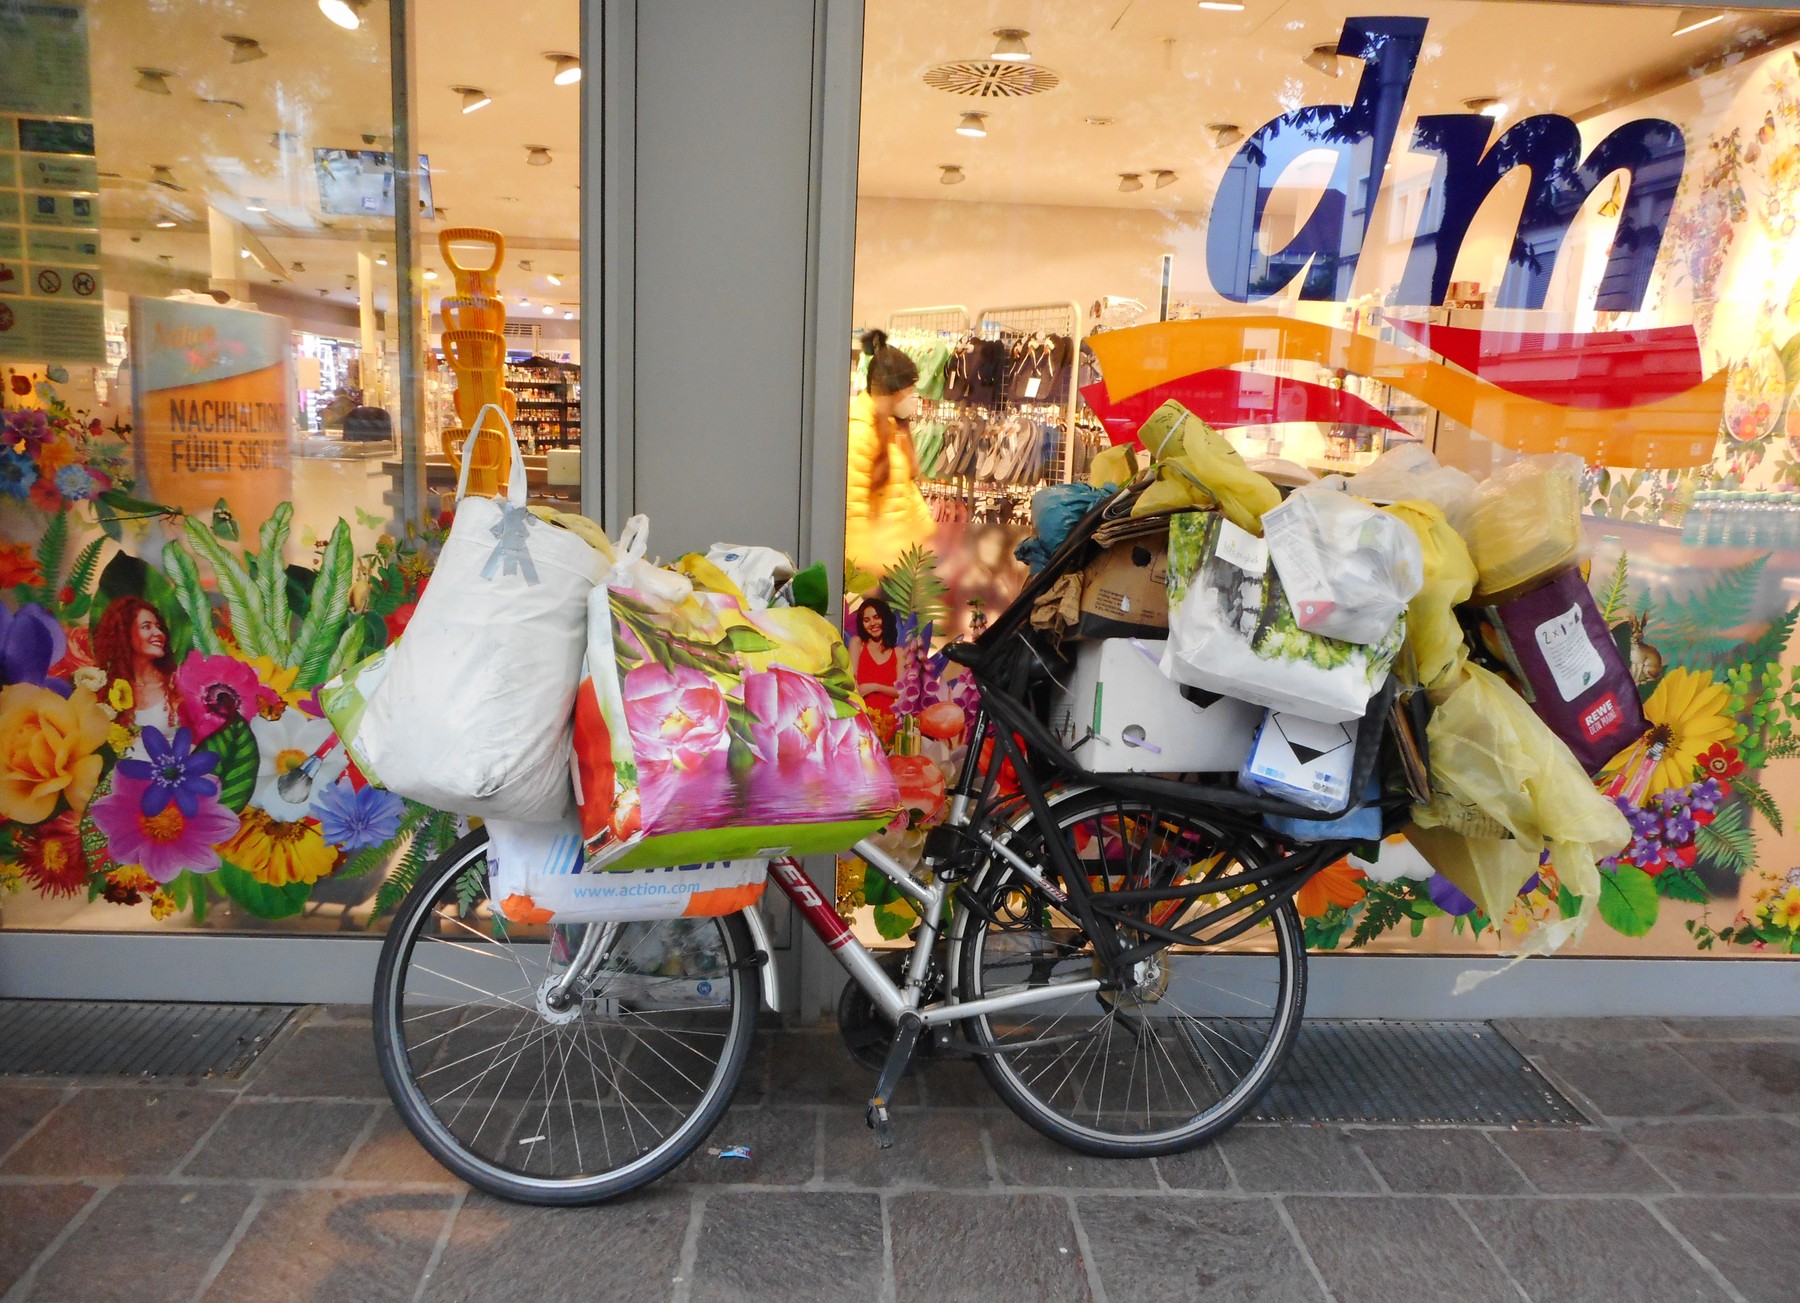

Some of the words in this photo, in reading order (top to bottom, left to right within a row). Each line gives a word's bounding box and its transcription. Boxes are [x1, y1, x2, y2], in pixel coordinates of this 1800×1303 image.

[1206, 16, 1687, 313] dm
[171, 434, 233, 473] FÜHLT
[1585, 699, 1614, 727] REWE
[573, 882, 700, 899] www.action.com
